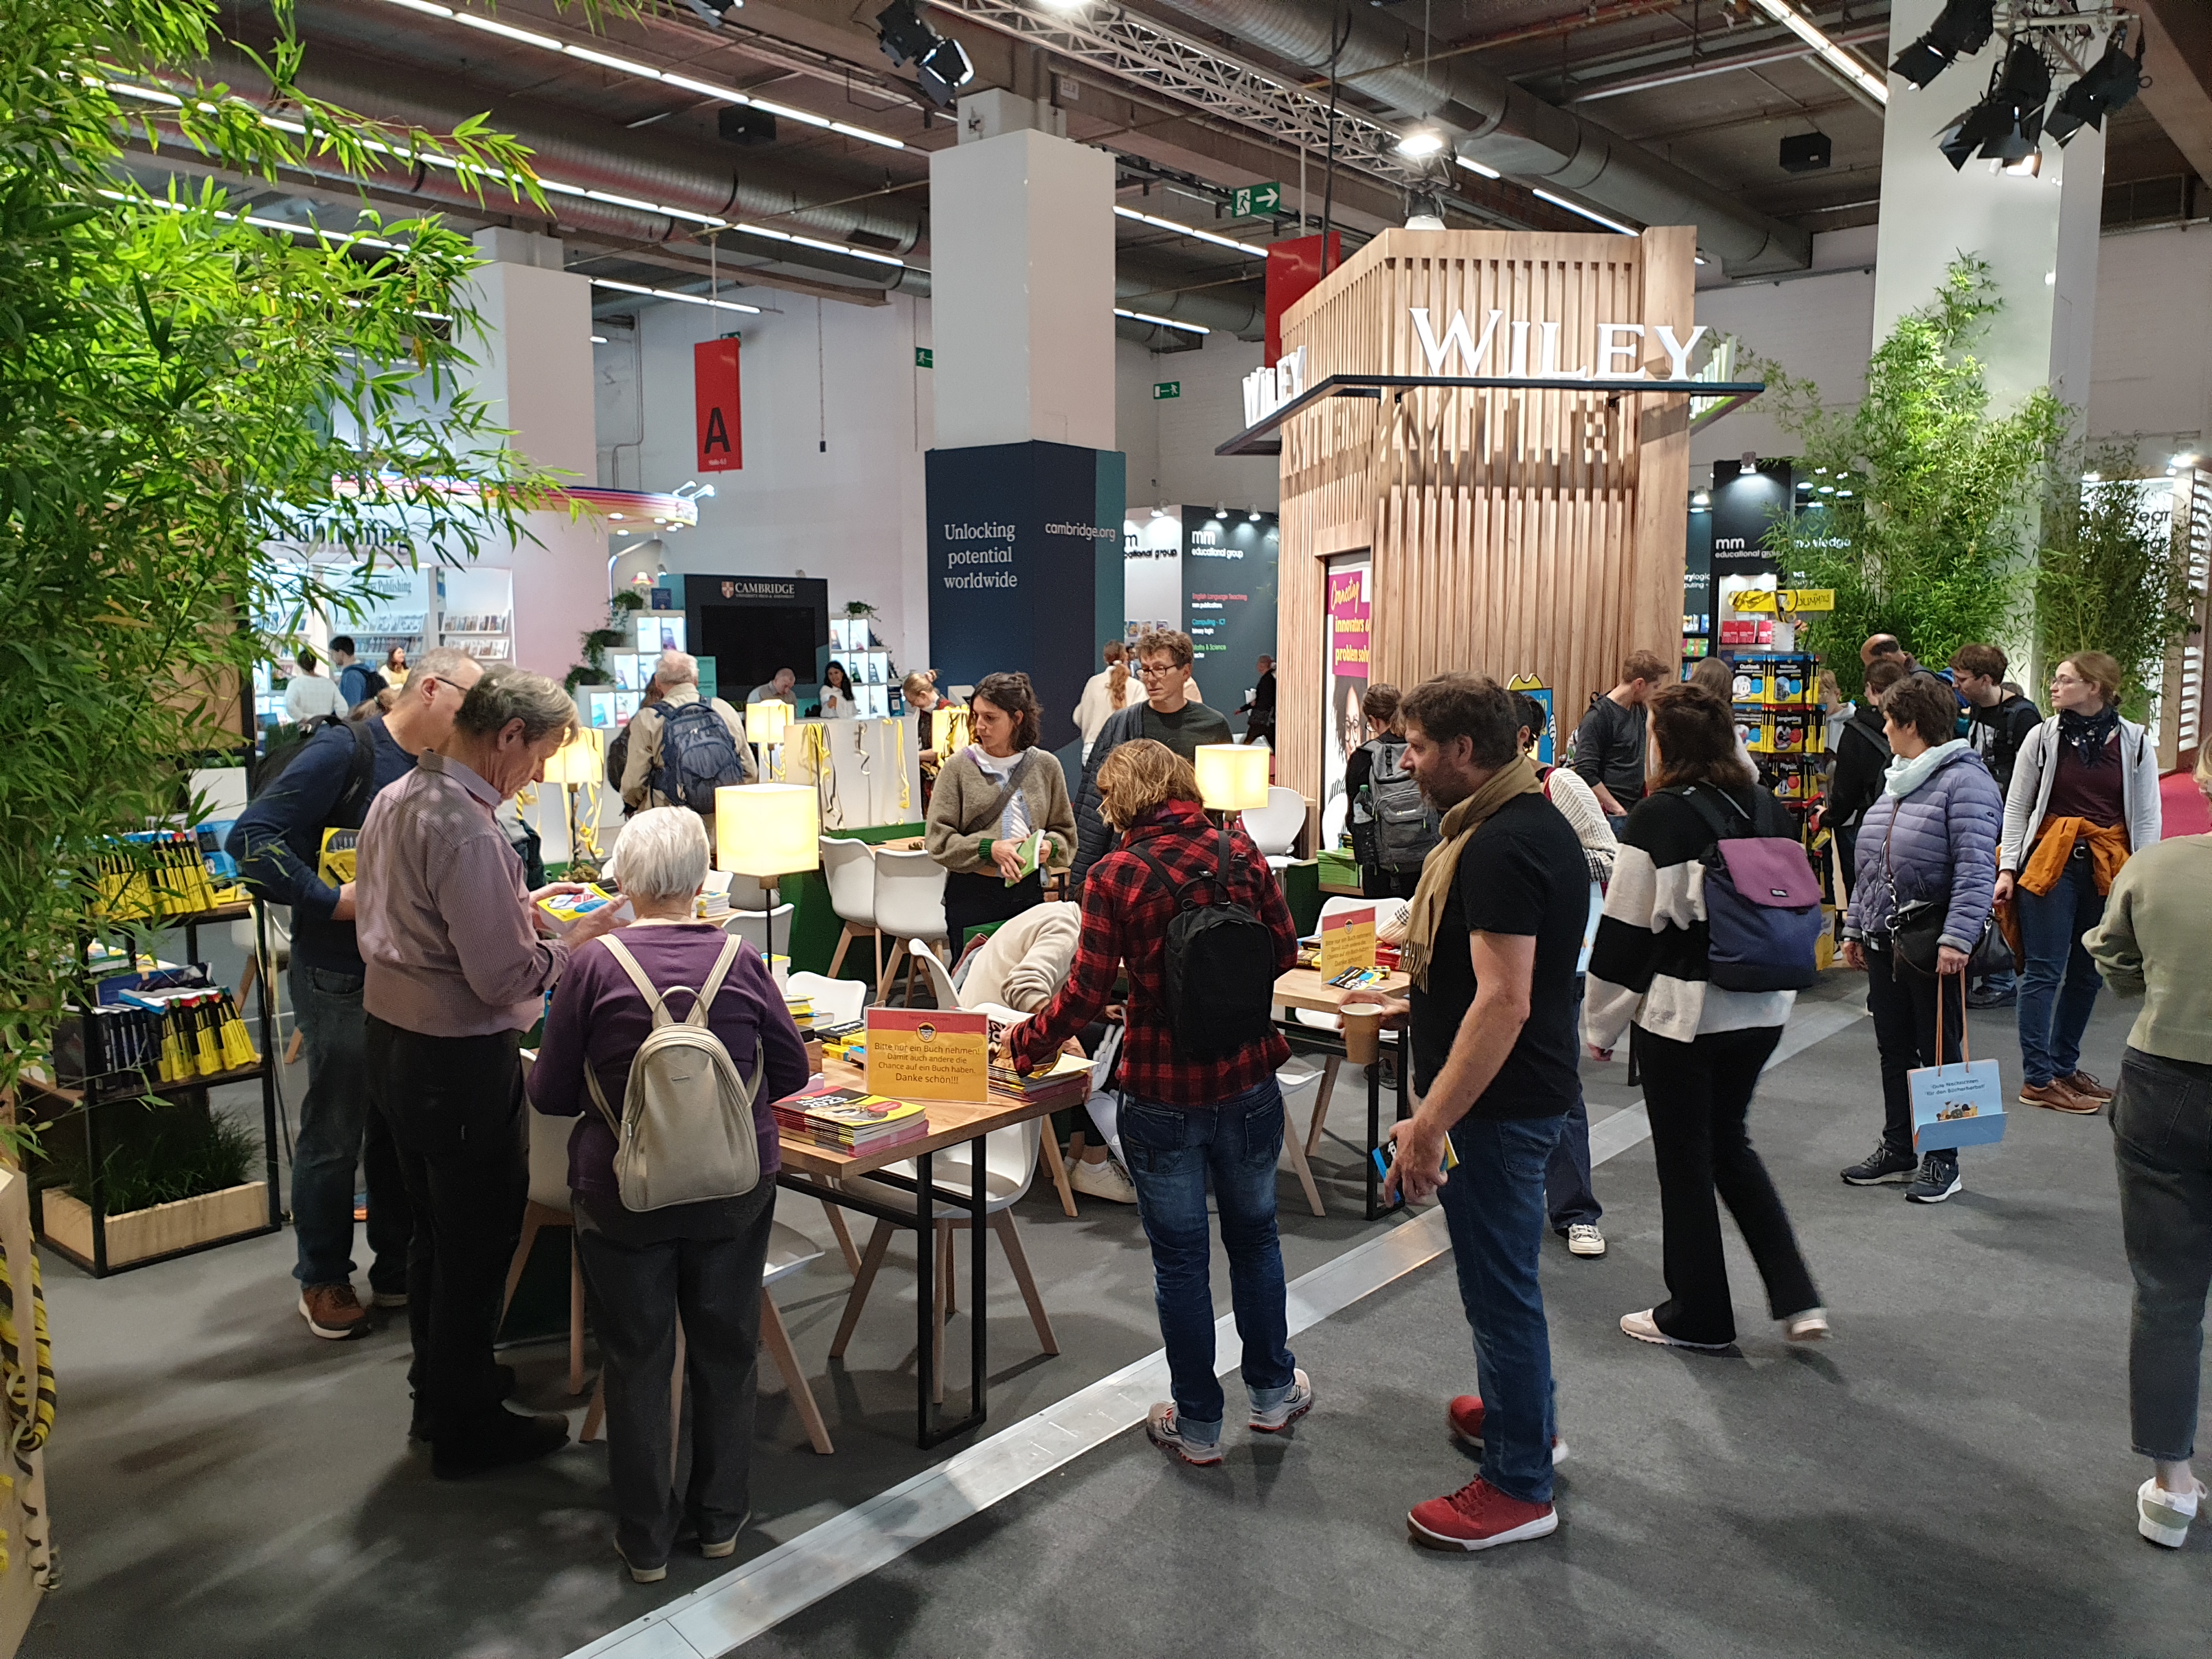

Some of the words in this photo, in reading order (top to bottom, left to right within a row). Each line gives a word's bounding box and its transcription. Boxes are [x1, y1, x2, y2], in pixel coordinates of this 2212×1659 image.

[1409, 308, 1708, 381] WILEY
[1243, 345, 1307, 429] WILEY
[704, 407, 731, 454] A
[944, 522, 1015, 542] Unlocking
[1045, 522, 1116, 542] cambridge.org
[1192, 531, 1216, 545] mm
[1125, 534, 1138, 547] m
[1716, 537, 1745, 549] mm
[948, 546, 1012, 569] potential
[1155, 549, 1178, 560] group
[1191, 547, 1226, 557] educational
[1227, 549, 1244, 560] group
[1715, 549, 1760, 558] educational
[377, 579, 412, 594] Publishing
[944, 571, 1018, 589] worldwide
[735, 582, 795, 595] CAMBRIDGE
[1330, 577, 1360, 613] Connecting
[1335, 616, 1364, 633] innovators
[1335, 644, 1358, 666] problem
[1358, 645, 1370, 663] solv
[874, 1042, 893, 1051] Bitte
[945, 1046, 980, 1055] nehmen!
[887, 1053, 908, 1061] Damit
[878, 1062, 904, 1070] Chance
[932, 1064, 950, 1073] Buch
[896, 1073, 923, 1082] Danke
[926, 1074, 958, 1084] schön!!!
[802, 1096, 848, 1108] 2023
